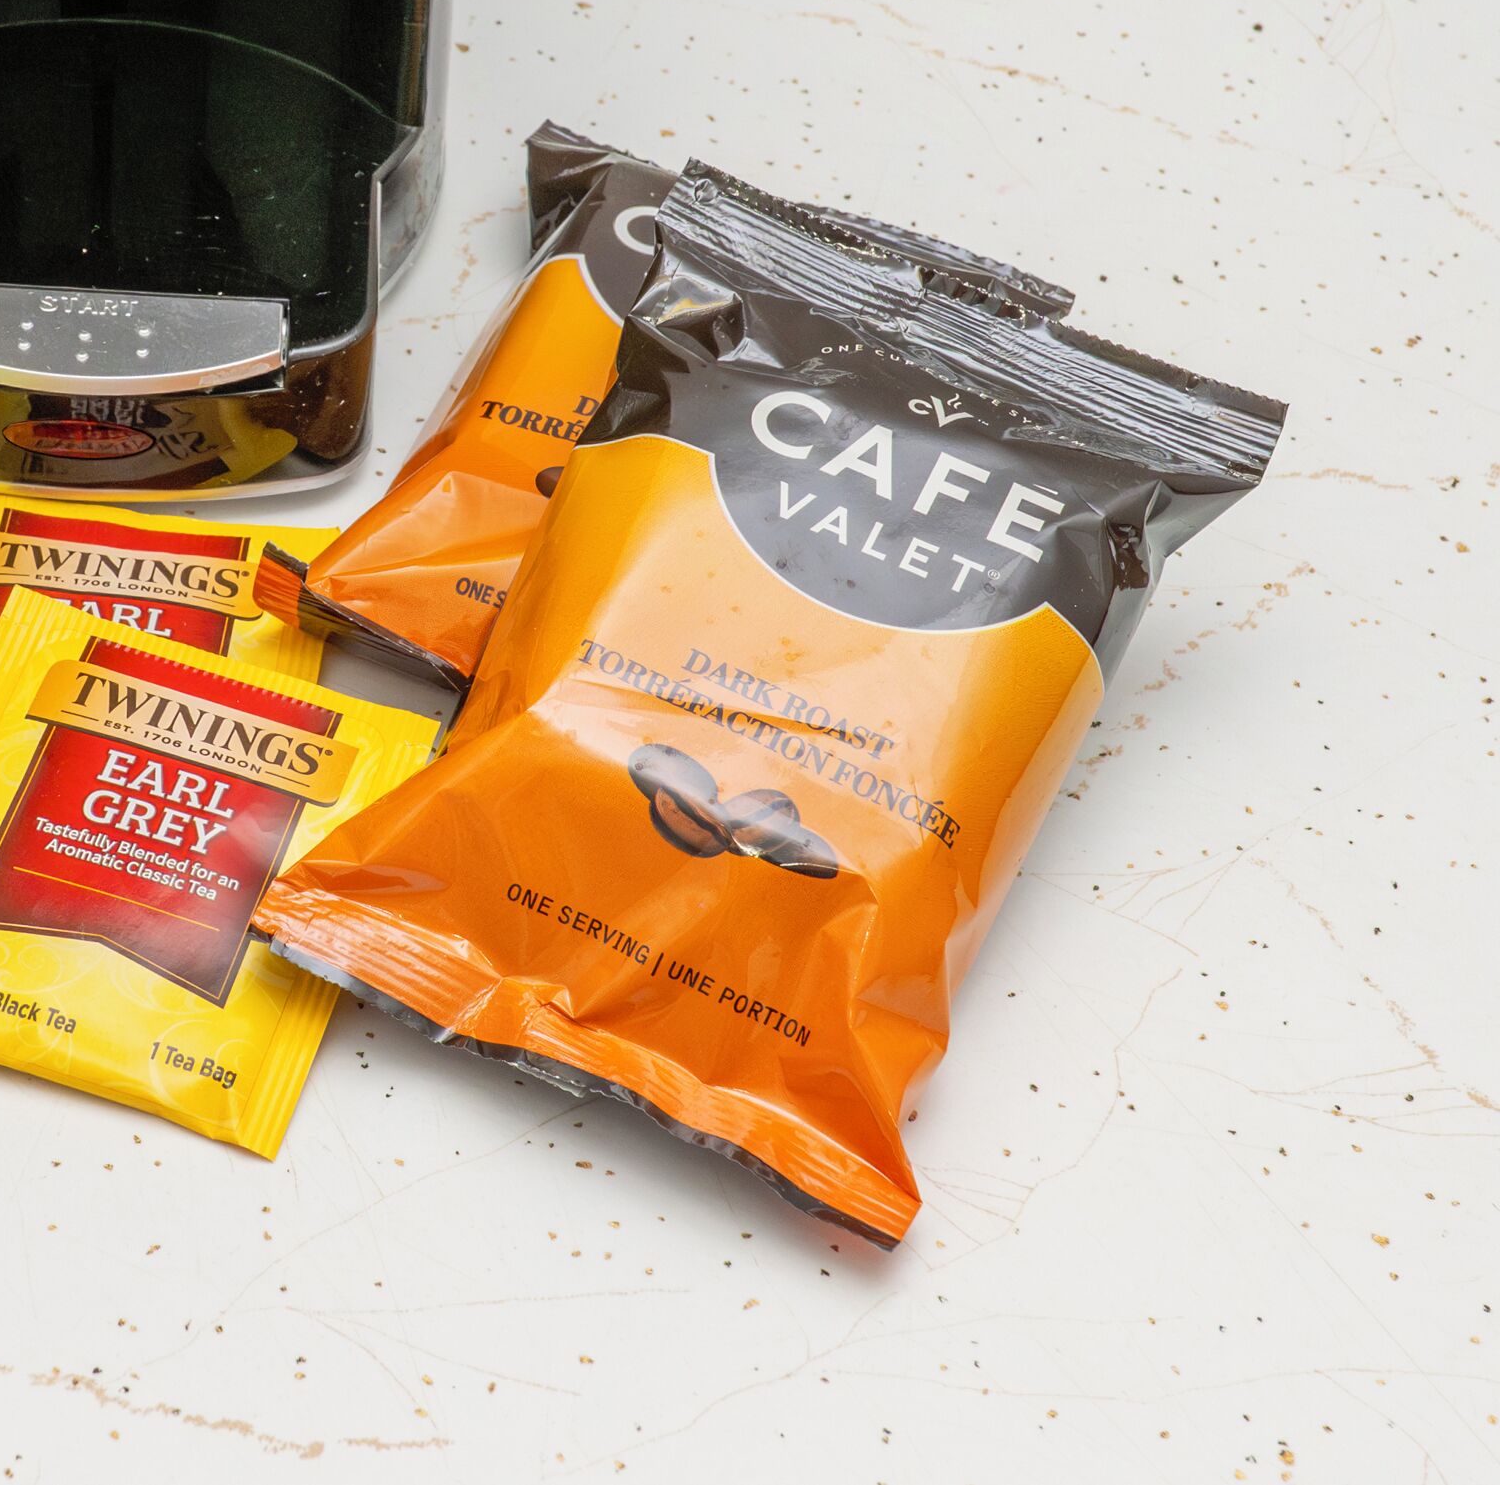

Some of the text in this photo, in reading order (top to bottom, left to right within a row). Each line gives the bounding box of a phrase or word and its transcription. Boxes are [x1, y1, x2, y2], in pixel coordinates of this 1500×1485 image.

[38, 294, 140, 318] START
[820, 343, 864, 355] ONE
[874, 348, 915, 366] CUP
[34, 573, 190, 599] EST. 1706 LONDON
[455, 576, 494, 607] ONE
[60, 597, 173, 638] ARL
[681, 647, 895, 761] DARK ROAST
[102, 718, 263, 775] EST. 1706 LONDON
[576, 638, 962, 850] TORRÉFACTION FONCÉE
[95, 748, 235, 819] EARL
[81, 788, 228, 856] GREY
[34, 815, 241, 892] Tastefully Blended for an
[44, 837, 218, 902] Aromatic Classic Tea
[506, 882, 555, 917] ONE
[557, 904, 650, 966] SERVING
[667, 960, 716, 997] UNE
[717, 986, 812, 1048] PORTION
[45, 1006, 78, 1034] Tea
[149, 1040, 238, 1090] 1 Tea Bag
